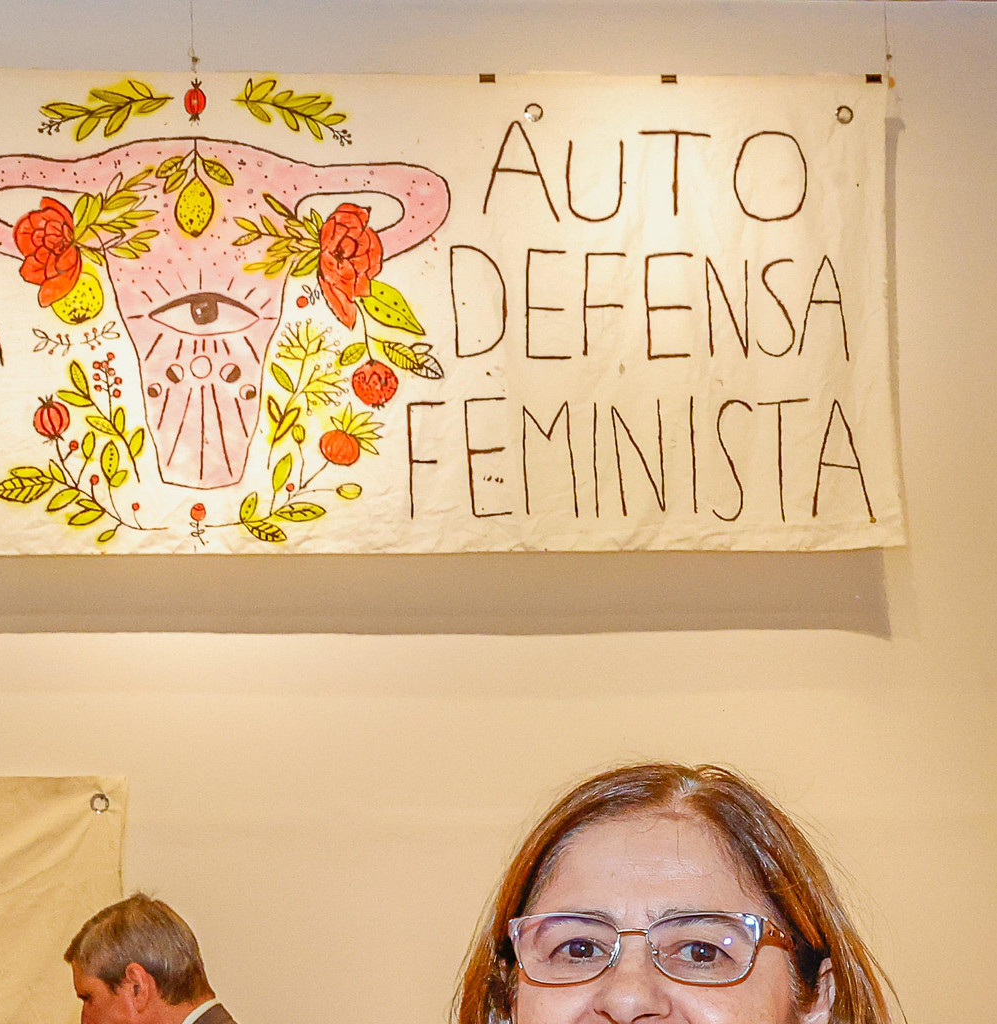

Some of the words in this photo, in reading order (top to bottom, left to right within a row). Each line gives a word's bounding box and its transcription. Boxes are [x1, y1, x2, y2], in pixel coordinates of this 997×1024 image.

[483, 121, 808, 223] AUTO
[450, 245, 850, 361] DEFENSA
[406, 396, 876, 523] FEMINISTA
